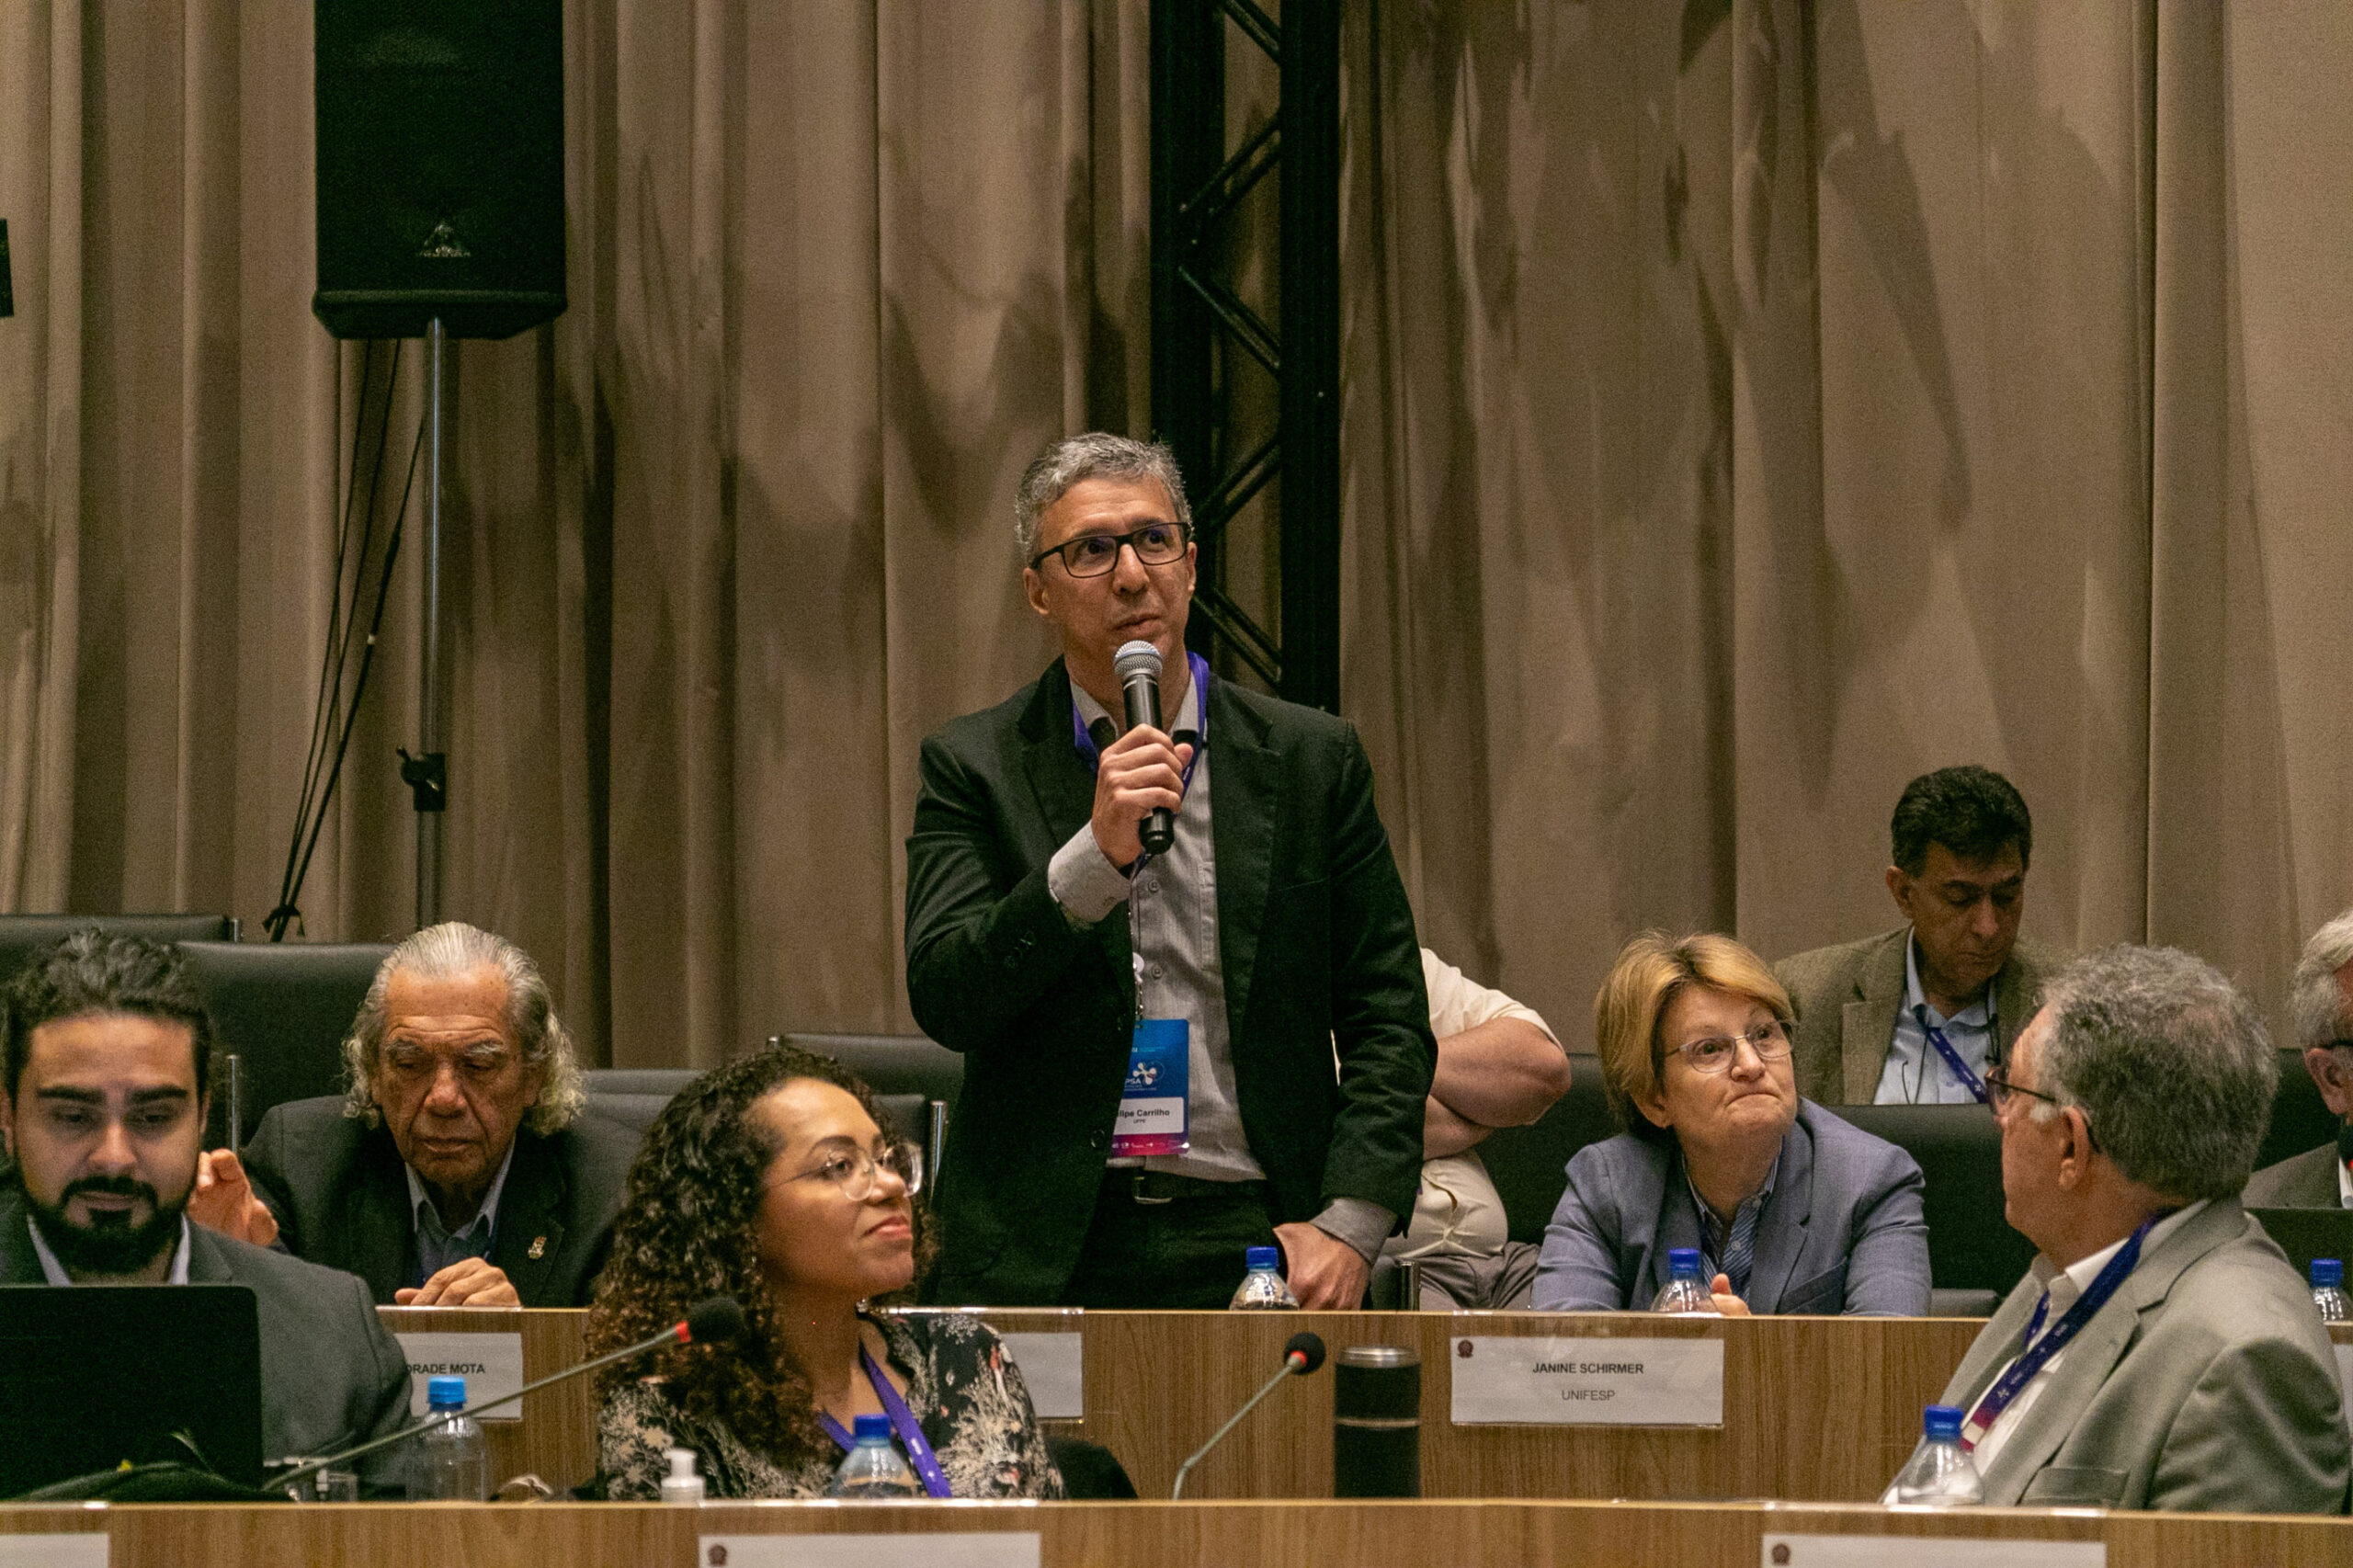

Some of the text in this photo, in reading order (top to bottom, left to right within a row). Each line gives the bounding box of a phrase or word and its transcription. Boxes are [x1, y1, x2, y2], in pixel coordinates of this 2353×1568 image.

[1137, 1108, 1170, 1117] Carrilho
[405, 1364, 485, 1374] DRADE MOTA
[1532, 1363, 1643, 1374] JANINE SCHIRMER
[1562, 1390, 1616, 1401] UNIFESP
